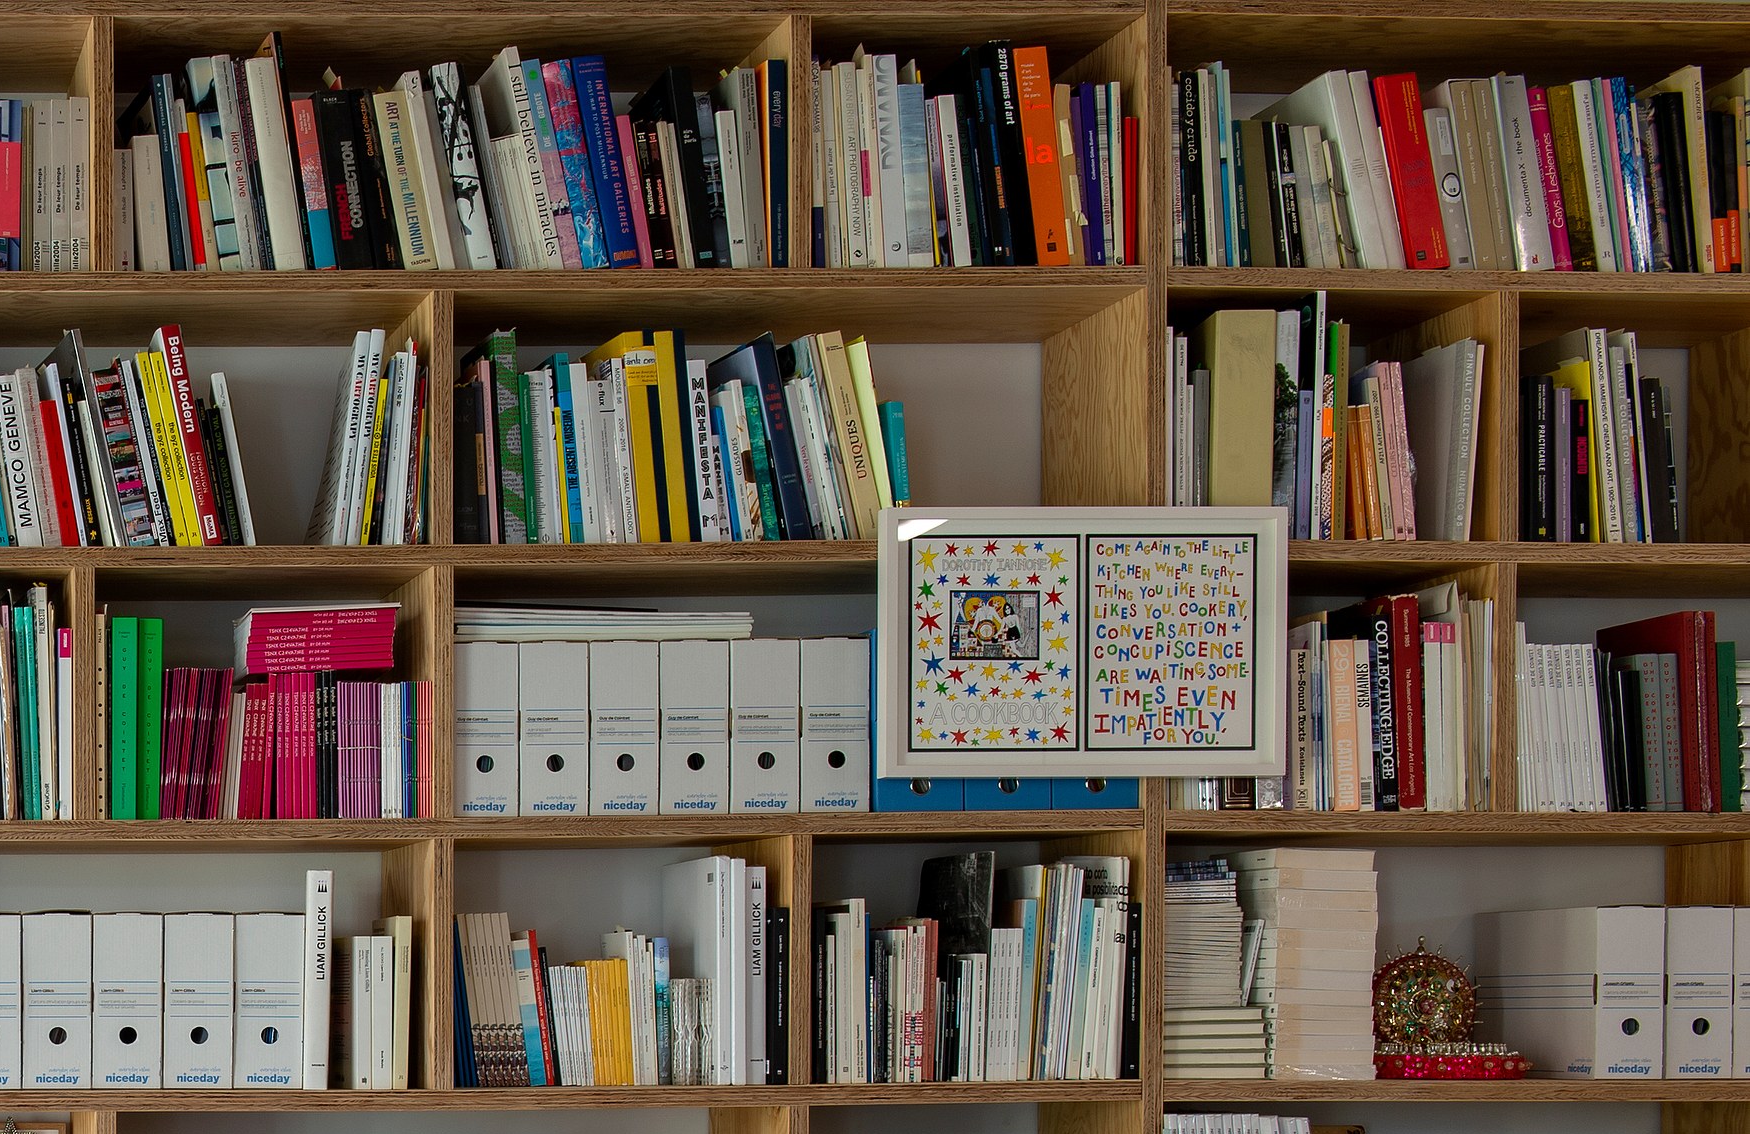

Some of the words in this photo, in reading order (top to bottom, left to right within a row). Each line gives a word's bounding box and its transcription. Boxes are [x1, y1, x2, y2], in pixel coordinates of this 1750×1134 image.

[998, 48, 1007, 71] 2870
[511, 74, 528, 104] still
[1001, 73, 1010, 98] grams
[1005, 98, 1011, 109] of
[1184, 78, 1196, 117] cocido
[385, 102, 399, 120] ART
[596, 79, 615, 155] INTERNATIONAL
[874, 55, 892, 170] DYNAMO
[1006, 113, 1016, 125] art
[390, 122, 398, 131] AT
[520, 110, 536, 164] believe
[1513, 117, 1521, 139] book
[391, 133, 400, 148] THE
[1187, 128, 1196, 162] crudo
[394, 149, 405, 166] TURN
[609, 159, 619, 178] ART
[1545, 133, 1561, 193] Lesbiennes
[342, 141, 364, 229] CONNECTION
[531, 171, 542, 186] in
[947, 133, 957, 182] performative
[952, 184, 963, 227] installation
[336, 183, 354, 240] FRENCH
[613, 183, 629, 234] GALLERIES
[1553, 204, 1564, 229] Gays
[404, 193, 425, 256] MILLENNIUM
[534, 193, 556, 257] miracles
[167, 336, 184, 378] Being
[176, 381, 195, 433] Modern
[349, 372, 363, 441] CARTOGRAPHY
[692, 377, 716, 502] MANIFESTA
[846, 419, 867, 480] UNIQUES
[12, 458, 31, 527] MAMCO
[205, 516, 216, 538] MoMA
[1096, 543, 1131, 556] COME
[1174, 545, 1185, 558] TO
[1187, 540, 1209, 553] THE
[942, 559, 993, 571] DOROTHY
[1155, 562, 1193, 579] WHERE
[1139, 585, 1163, 599] YOU
[1096, 669, 1129, 683] ARE
[1356, 664, 1370, 708] SEMAINES
[1178, 686, 1236, 710] EVEN
[929, 703, 951, 724] A
[954, 702, 1058, 724] COOKBOOK
[1144, 728, 1177, 744] FOR
[1182, 730, 1219, 745] YOU.
[1298, 714, 1306, 742] Texts
[463, 800, 506, 812] niceday
[673, 798, 717, 810] niceday
[814, 797, 858, 808] niceday
[316, 906, 326, 951] GILLICK
[316, 955, 325, 980] LIAM
[36, 1074, 79, 1085] niceday
[247, 1073, 290, 1084] niceday
[1608, 1063, 1650, 1076] niceday
[1679, 1063, 1720, 1075] niceday
